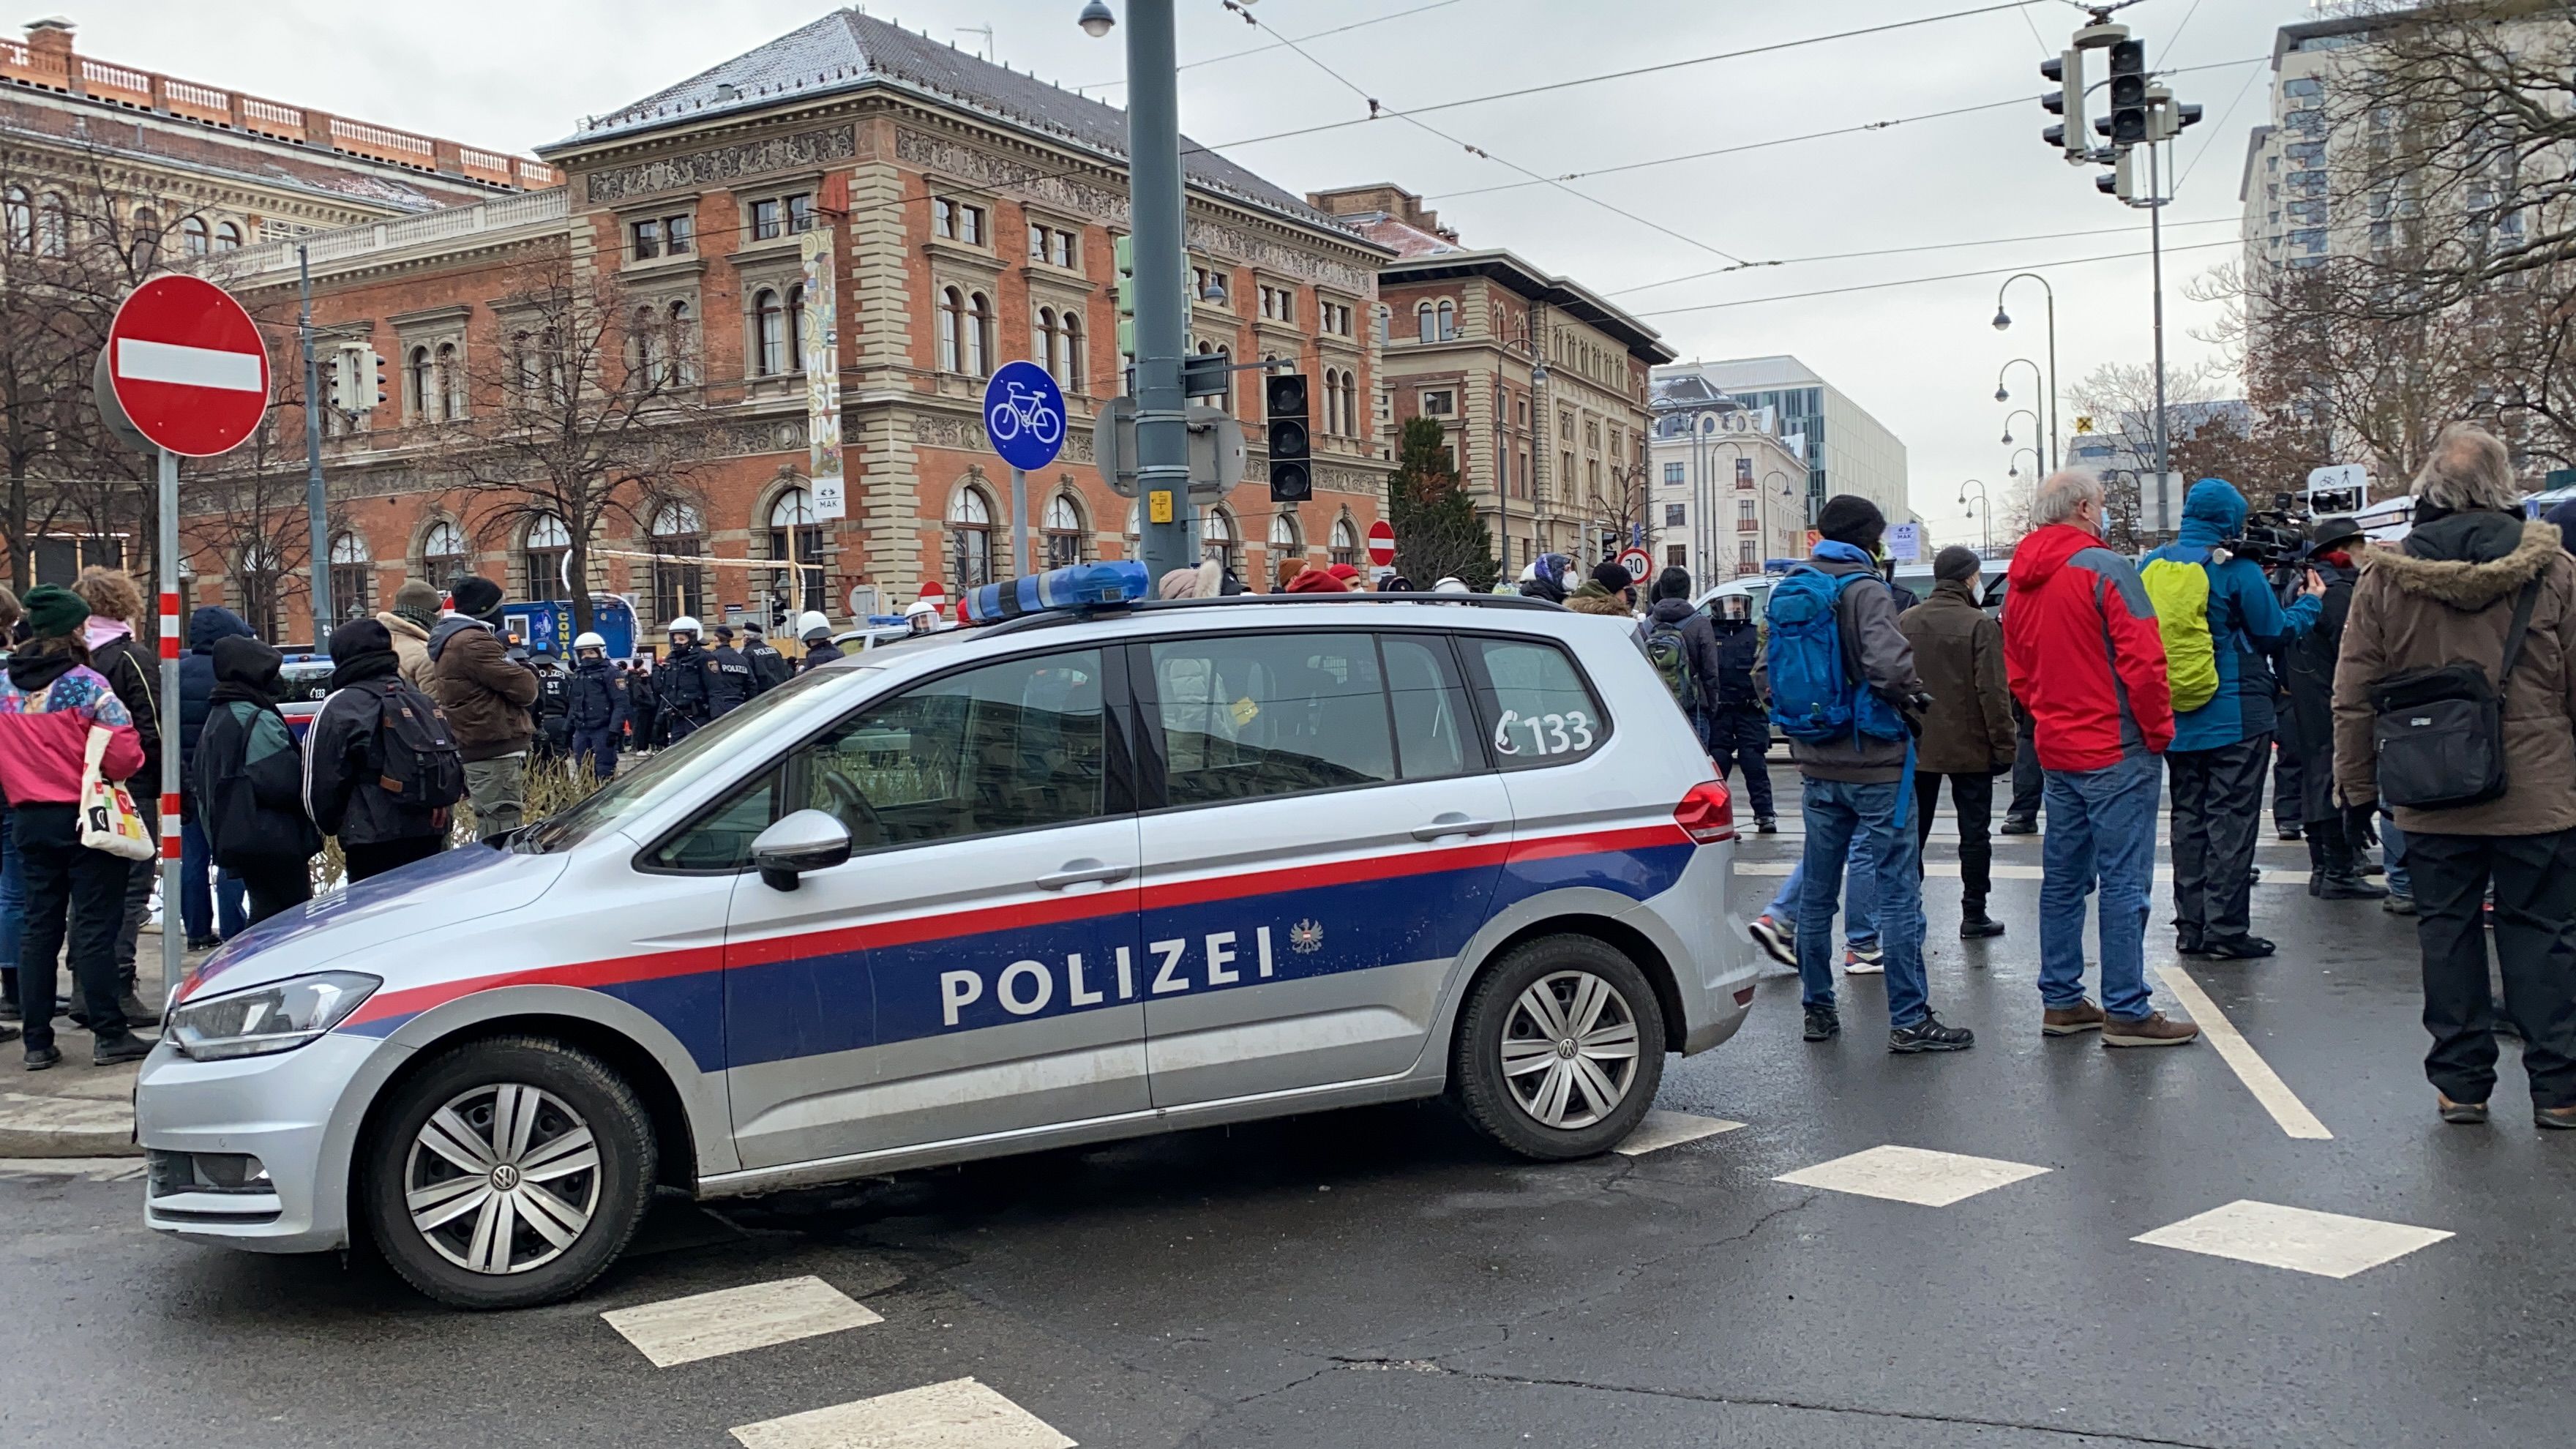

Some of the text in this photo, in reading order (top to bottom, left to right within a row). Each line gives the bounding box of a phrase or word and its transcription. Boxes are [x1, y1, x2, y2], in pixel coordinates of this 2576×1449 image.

[820, 500, 838, 509] MAK
[722, 664, 748, 674] POLIZEI
[1524, 711, 1593, 755] 133
[940, 926, 1273, 1026] POLIZEI
